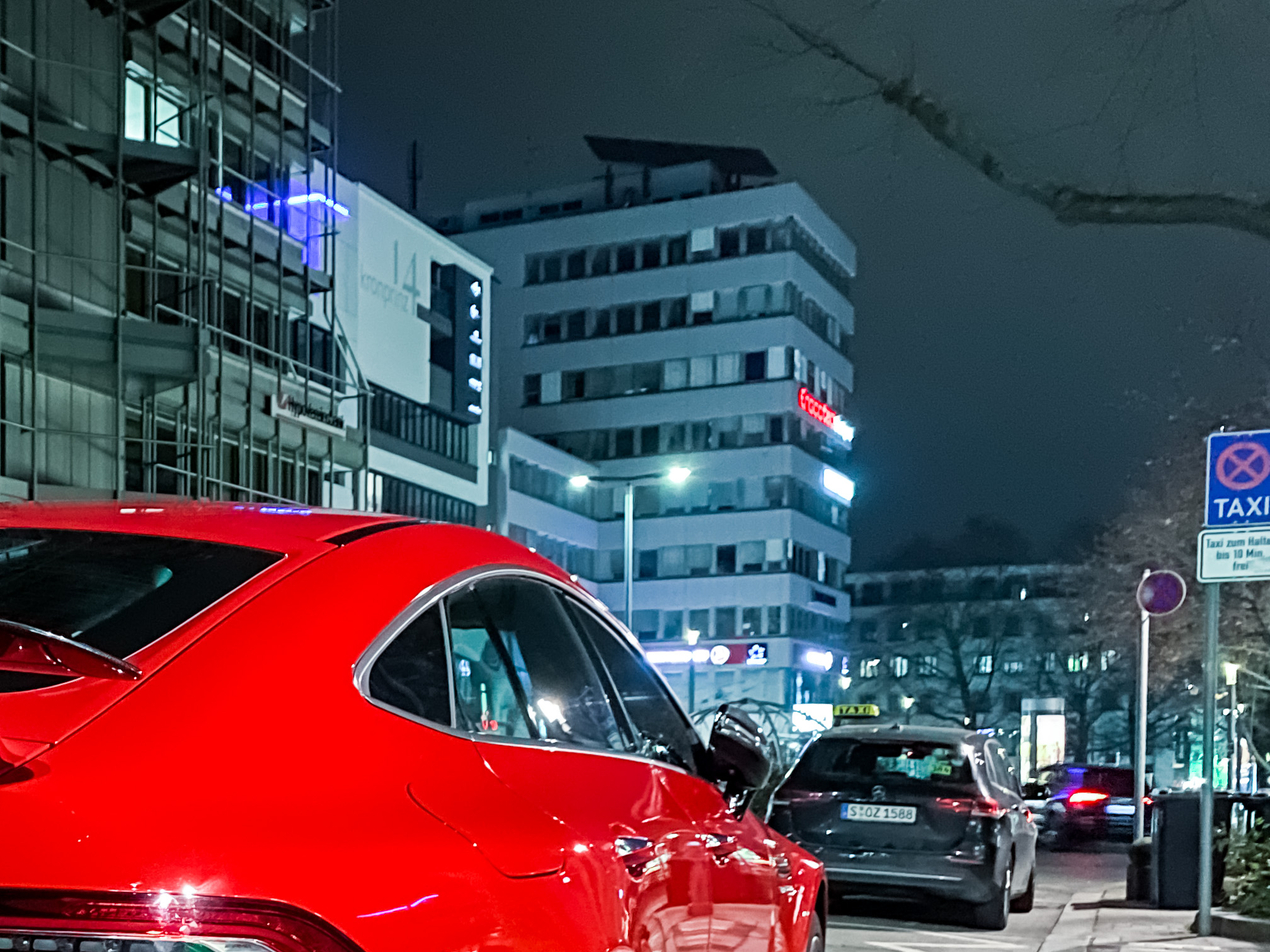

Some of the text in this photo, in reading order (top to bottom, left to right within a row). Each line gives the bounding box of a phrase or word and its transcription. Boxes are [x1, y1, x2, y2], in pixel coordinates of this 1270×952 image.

[1213, 496, 1270, 518] TAXI
[1207, 538, 1224, 548] Taxi
[1226, 539, 1245, 548] zum
[1216, 550, 1230, 560] bis
[1234, 549, 1243, 559] 10
[1232, 561, 1248, 571] frei
[849, 806, 858, 817] S
[883, 807, 913, 820] 1588
